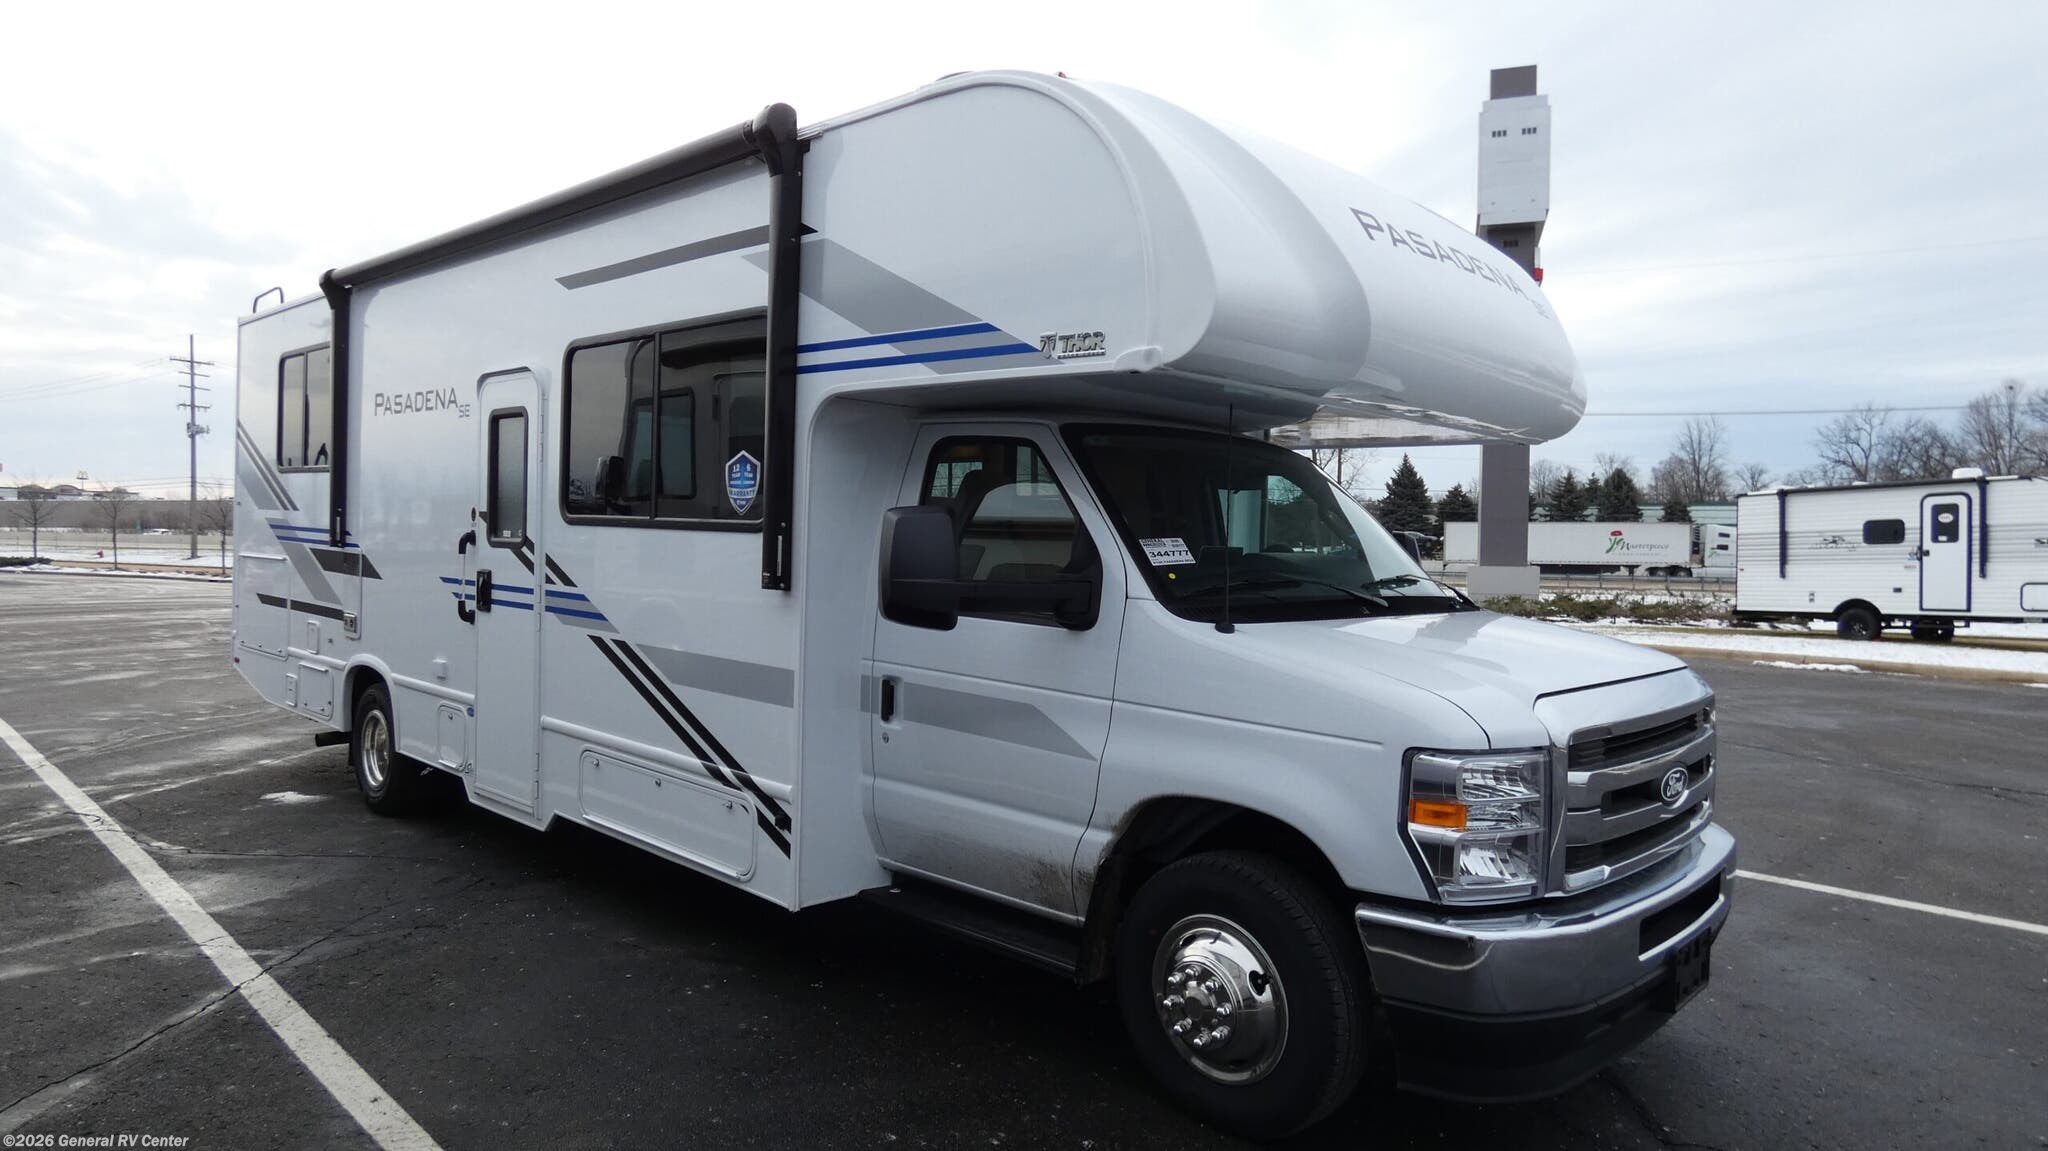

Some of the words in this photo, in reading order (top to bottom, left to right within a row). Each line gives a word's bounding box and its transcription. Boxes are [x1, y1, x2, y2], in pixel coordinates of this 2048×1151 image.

[1349, 207, 1529, 301] PASADENA
[1058, 331, 1106, 353] THOR
[374, 387, 458, 416] PASADENA
[458, 403, 471, 418] SE
[1149, 550, 1189, 558] 344777
[1665, 770, 1685, 798] Ford
